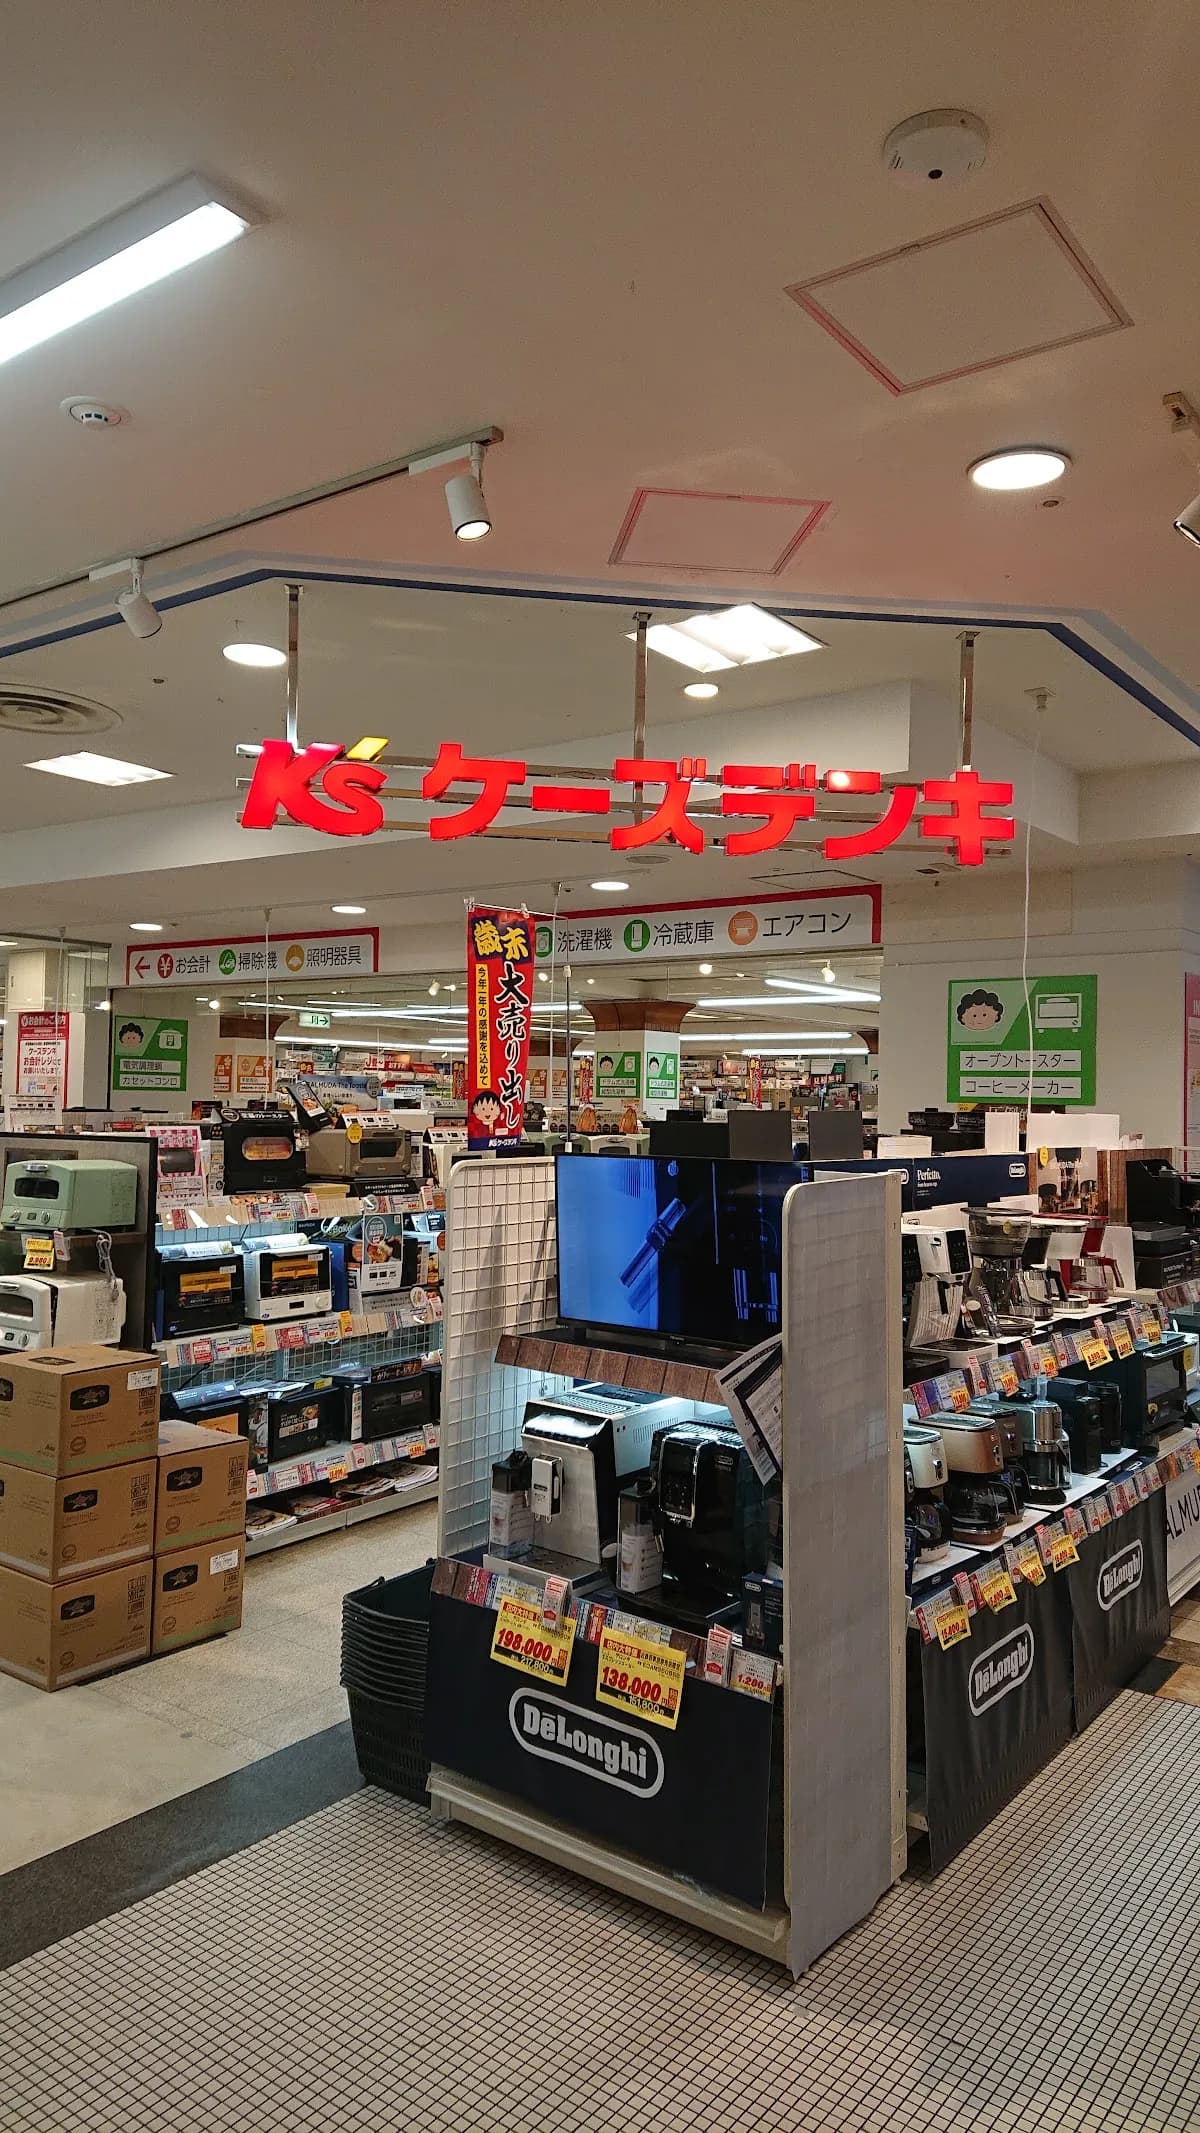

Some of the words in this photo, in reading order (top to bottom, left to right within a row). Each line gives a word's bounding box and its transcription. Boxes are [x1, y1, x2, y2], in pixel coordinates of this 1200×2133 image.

[242, 737, 390, 836] K's
[422, 742, 1015, 866] ケーズデンキ
[474, 919, 529, 961] 歳末
[557, 927, 613, 952] 洗濯機
[653, 920, 715, 947] 冷蔵庫
[762, 912, 852, 938] エアコン
[175, 956, 211, 974] お会計
[237, 951, 278, 972] 掃除機
[306, 945, 362, 968] 照明器具
[494, 961, 529, 1130] 大売り出し
[965, 1053, 1076, 1069] オーブントースター
[122, 1076, 178, 1087] カセットコンロ
[965, 1079, 1075, 1095] コーヒーメーカー
[497, 1627, 553, 1662] 198,000
[602, 1665, 662, 1703] 138,000
